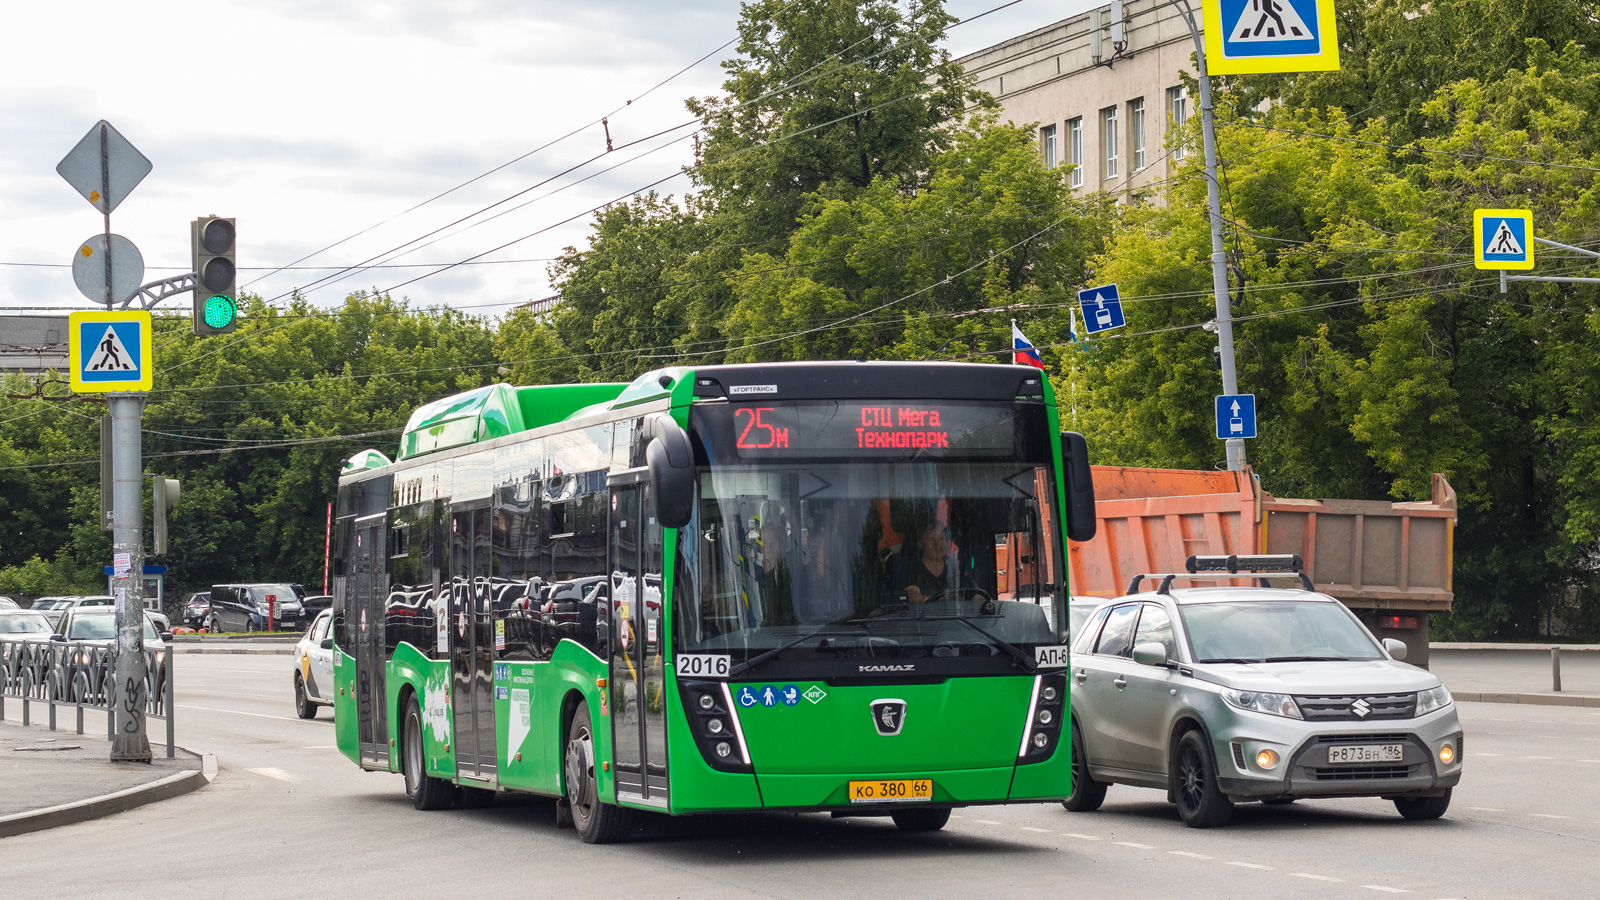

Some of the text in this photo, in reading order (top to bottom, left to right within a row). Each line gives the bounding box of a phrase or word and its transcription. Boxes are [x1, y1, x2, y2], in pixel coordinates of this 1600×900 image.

[861, 408, 940, 428] СТЦ Мега
[856, 428, 948, 448] Технопарк
[1038, 649, 1067, 665] АП-6
[679, 656, 728, 675] 2016
[858, 664, 916, 672] KAMAZ
[1382, 746, 1400, 755] 186
[880, 783, 906, 796] 380
[914, 781, 928, 792] 66
